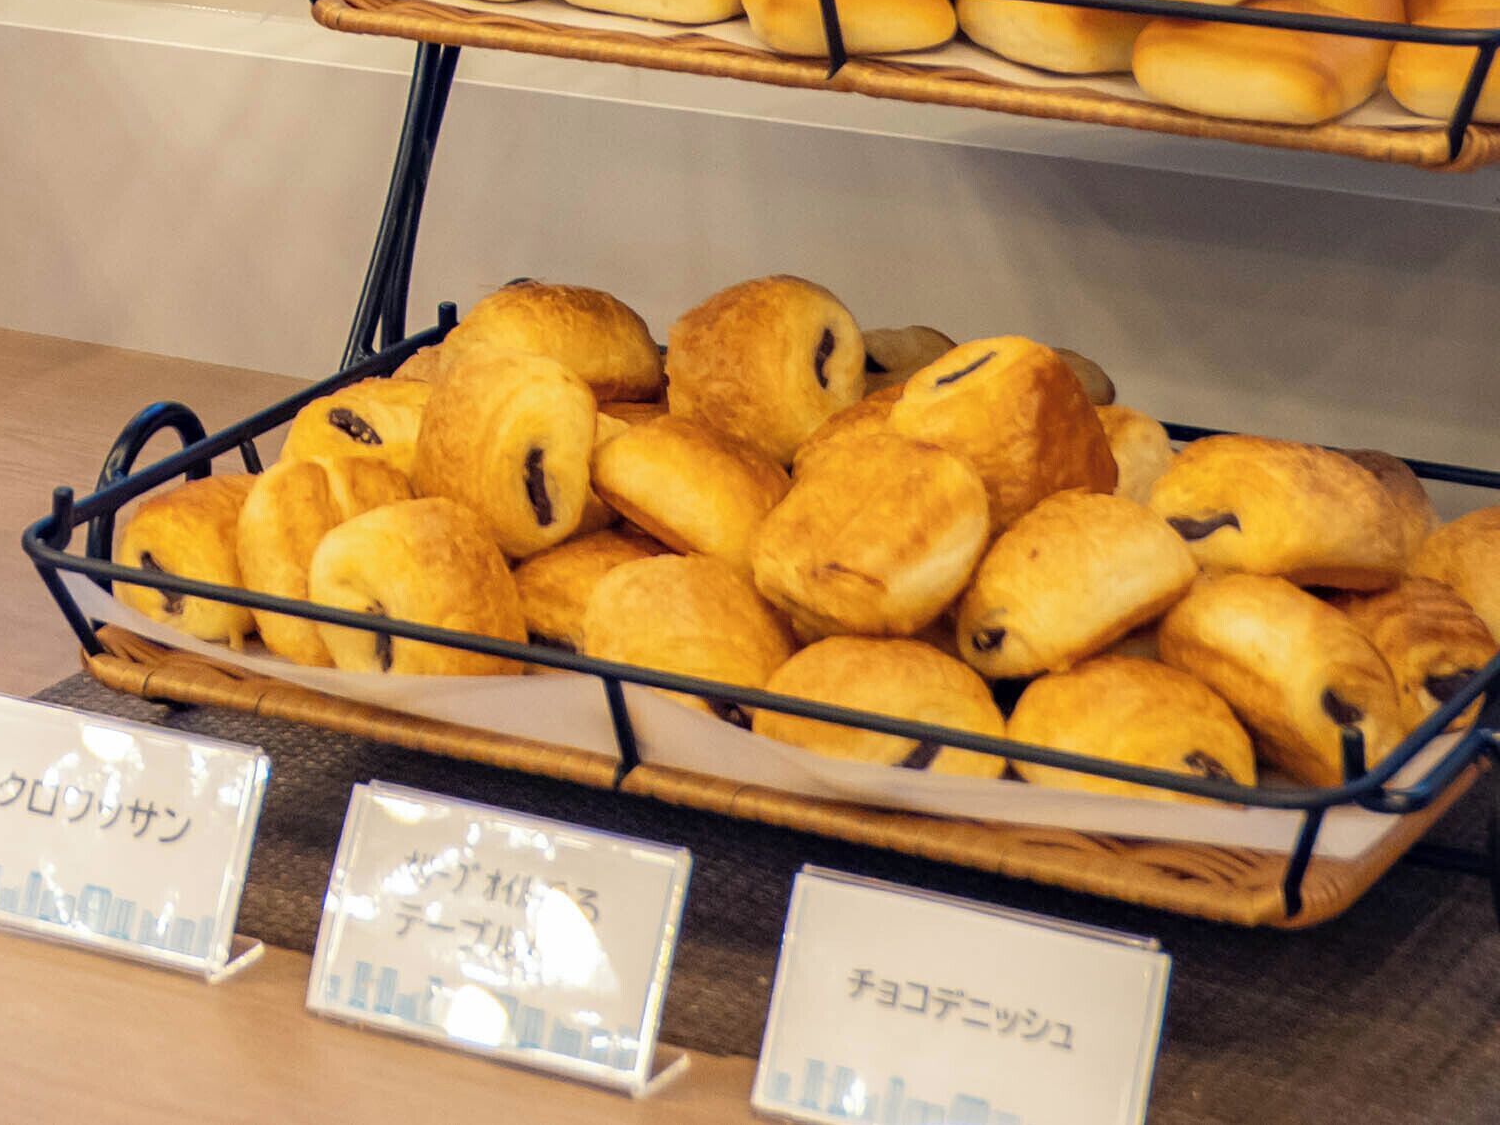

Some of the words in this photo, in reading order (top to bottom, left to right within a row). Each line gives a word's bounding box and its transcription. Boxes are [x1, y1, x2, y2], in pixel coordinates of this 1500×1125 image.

[847, 967, 1076, 1051] チョコデニッシュ
